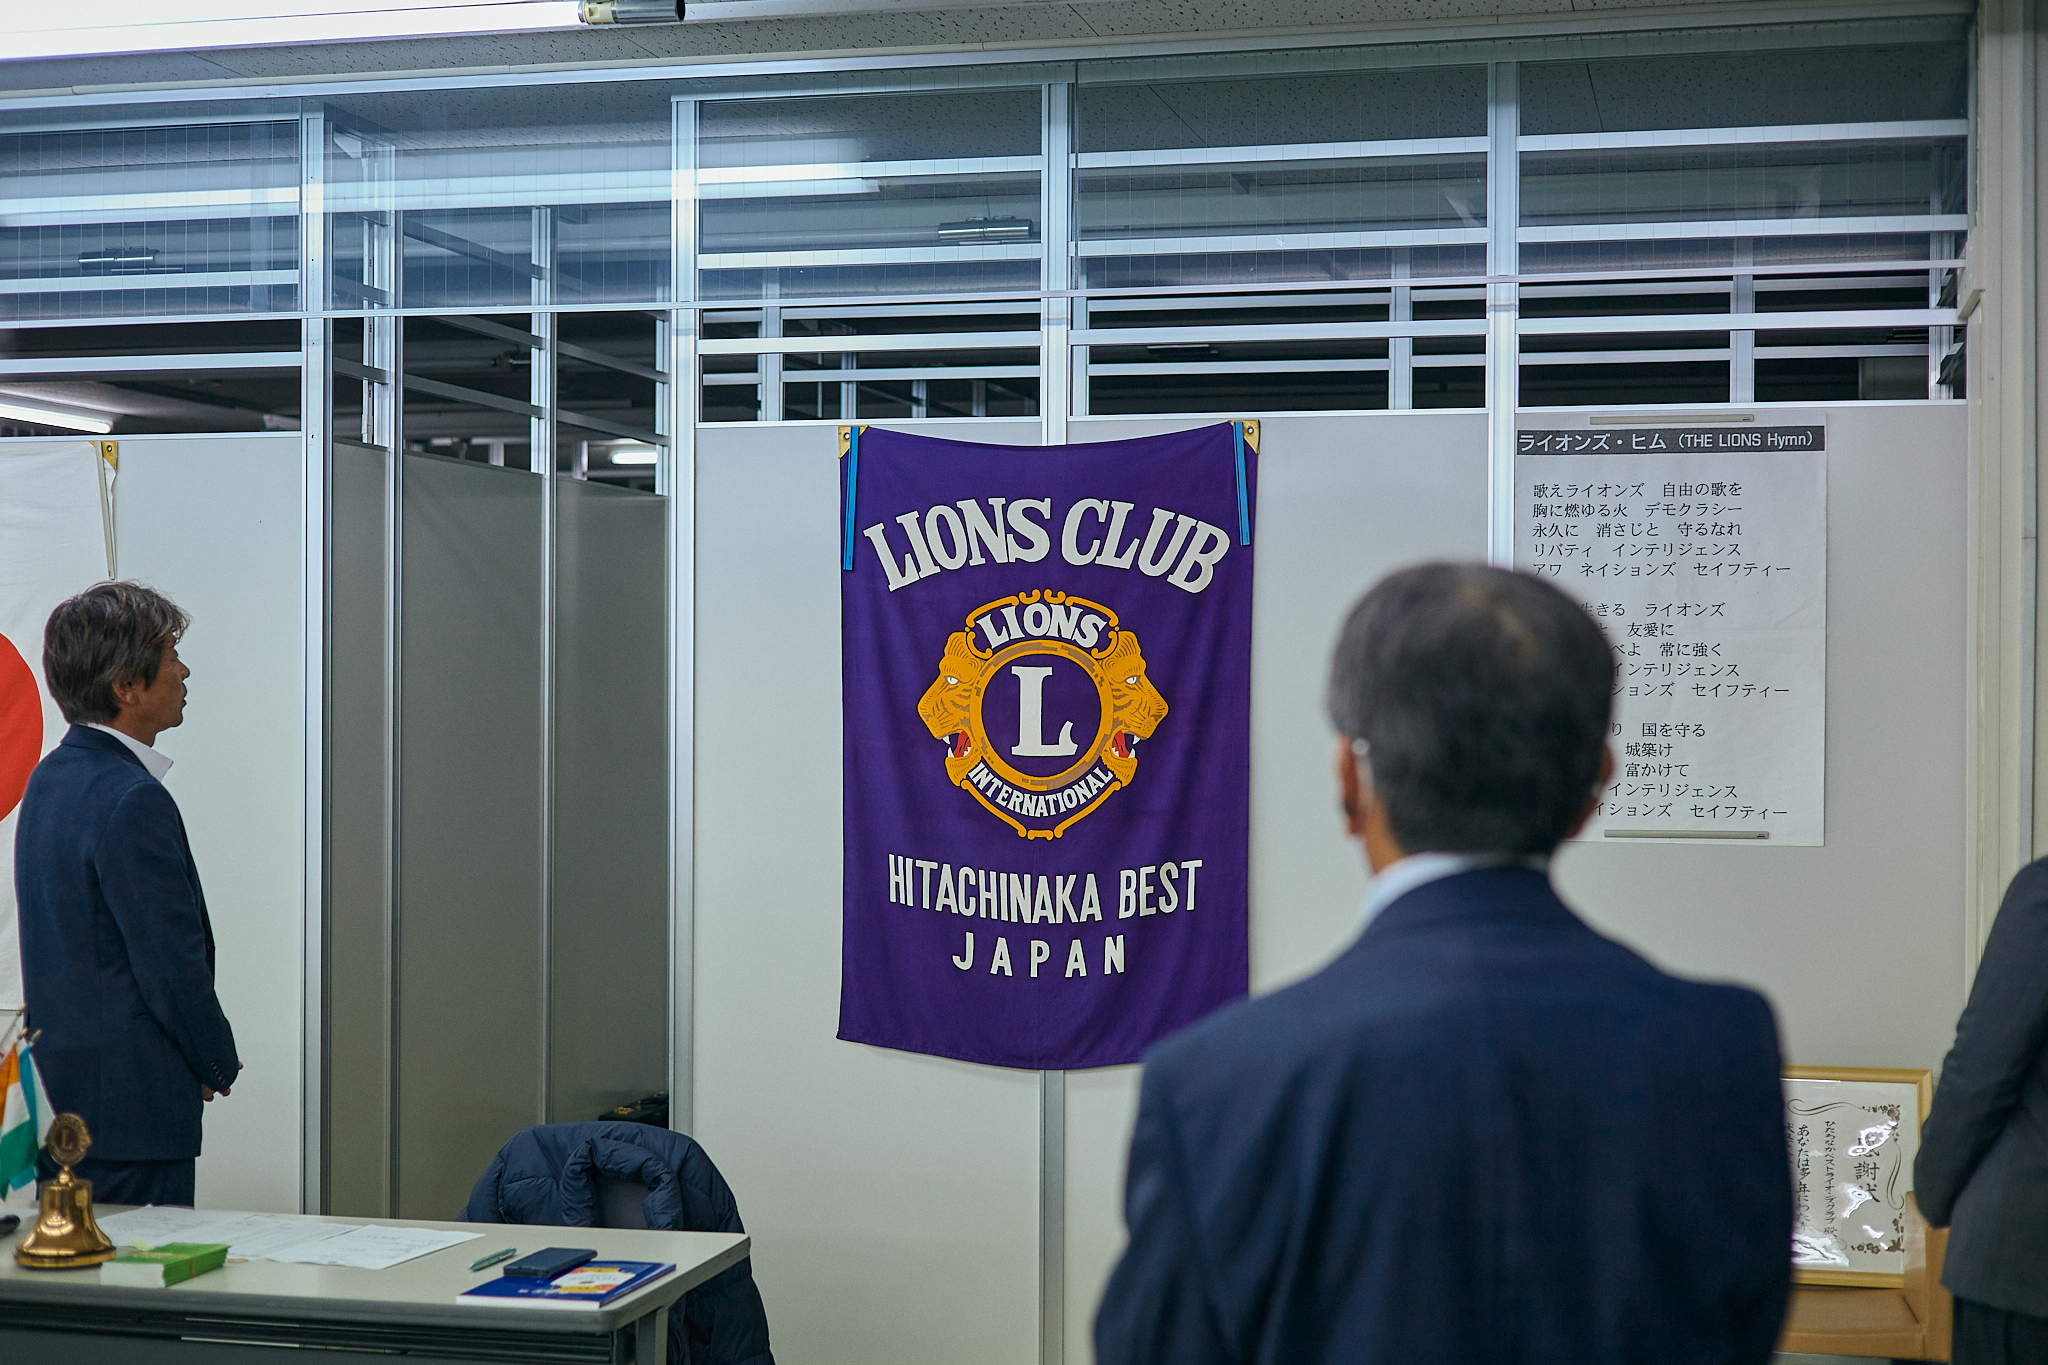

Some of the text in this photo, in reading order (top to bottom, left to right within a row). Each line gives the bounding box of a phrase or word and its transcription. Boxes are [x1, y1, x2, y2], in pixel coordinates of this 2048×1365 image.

[1519, 431, 1813, 452] ライオンズ・ヒム (THE LIONS Hymn)
[1533, 482, 1742, 498] 歌えライオンズ 自由の歌を
[1532, 502, 1743, 518] 胸に燃ゆる火 デモクラシー
[1532, 521, 1742, 538] 永久に 消さじと 守るなれ
[863, 497, 1231, 594] LIONS CLUB
[1534, 543, 1741, 558] リバティ インテリジェンス
[1533, 562, 1791, 577] アワ ネイションズ セイフティー
[1646, 602, 1725, 617] ライオンズ
[976, 602, 1107, 649] LIONS
[1627, 622, 1674, 637] 友愛に
[1660, 643, 1722, 657] 常に強く
[1612, 663, 1739, 677] インテリジェンス
[1692, 683, 1789, 698] セイフティー
[1010, 665, 1078, 757] L
[1642, 722, 1706, 737] 国を守る
[1626, 742, 1673, 758] 城築け
[1625, 763, 1689, 777] 富かけて
[967, 762, 1114, 818] INTERNATIONAL
[1608, 783, 1737, 798] インテリジェンス
[1690, 804, 1787, 819] セイフティー
[888, 854, 1203, 924] HITACHINAKA BEST
[952, 931, 1126, 979] JAPAN
